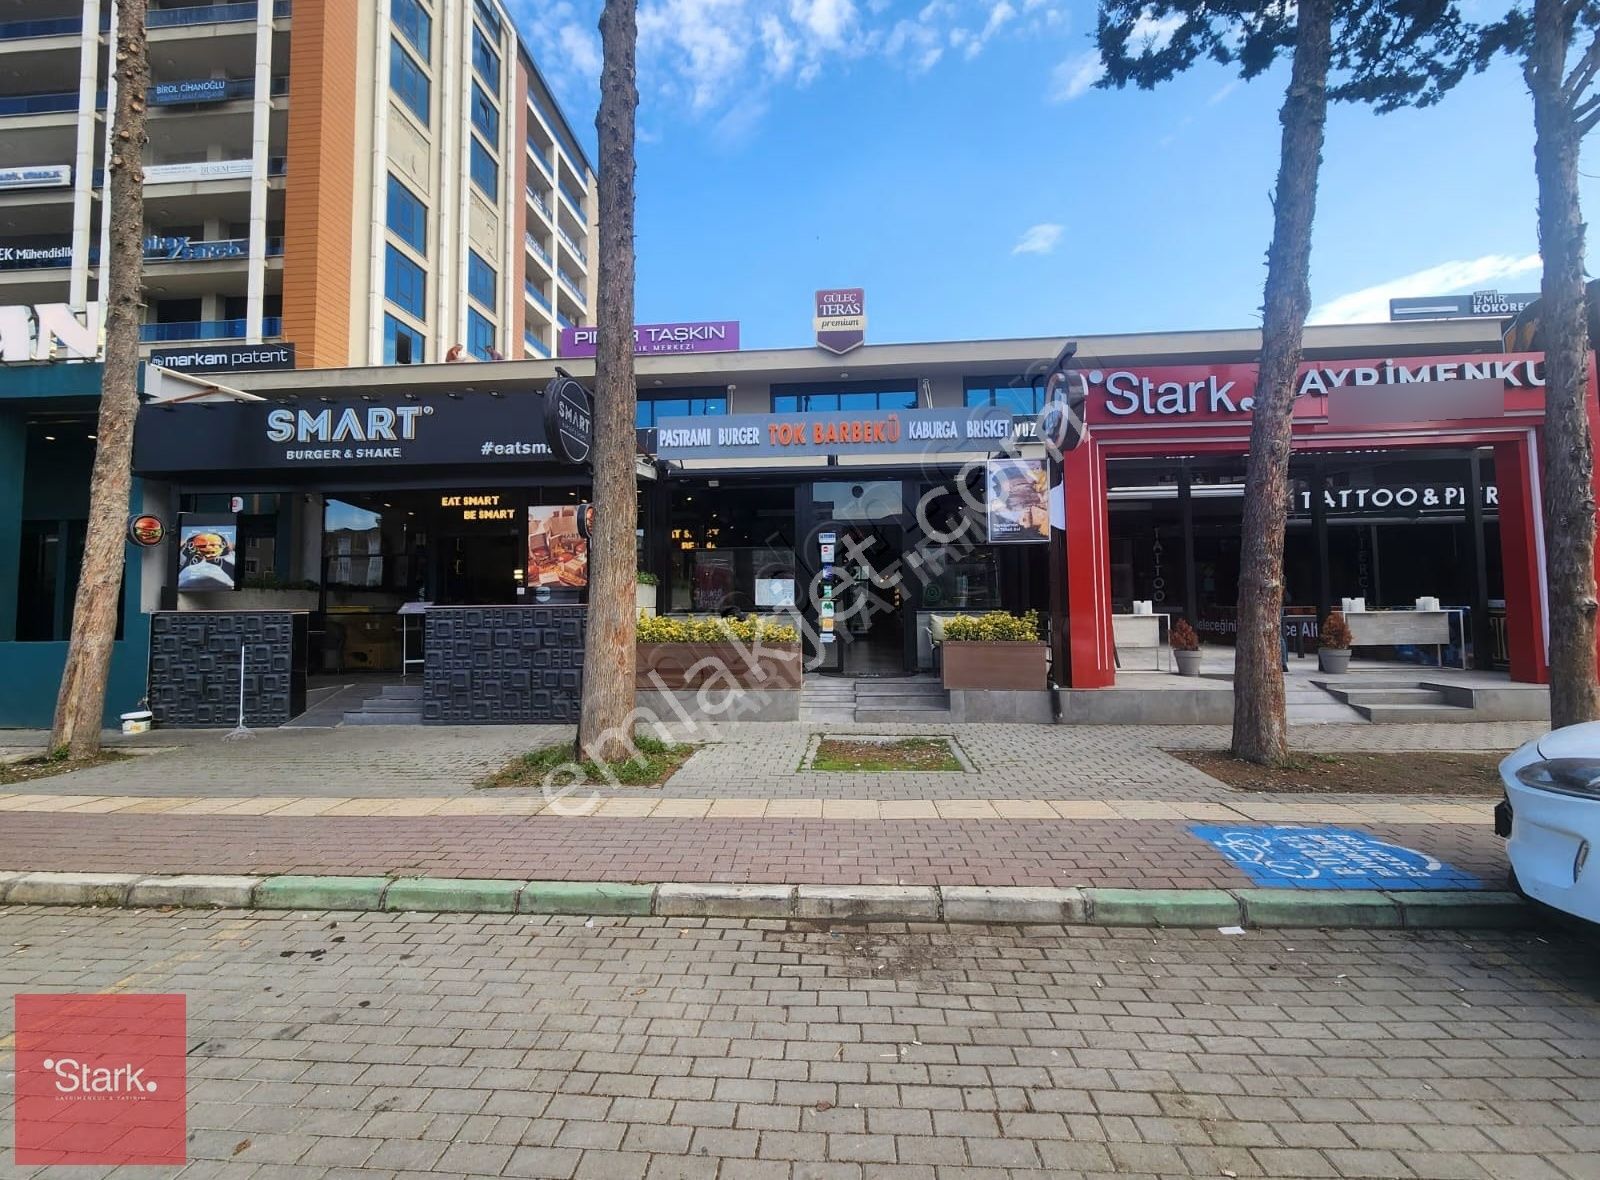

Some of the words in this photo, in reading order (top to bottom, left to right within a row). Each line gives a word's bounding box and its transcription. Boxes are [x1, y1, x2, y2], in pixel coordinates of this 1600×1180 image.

[16, 247, 74, 260] Mühendislik
[823, 292, 857, 304] GÜLEÇ
[820, 303, 861, 316] TERAS
[821, 318, 859, 329] premium
[646, 325, 725, 343] TAŞKIN
[165, 353, 228, 367] markam
[231, 349, 288, 366] patent
[266, 406, 422, 443] SMART
[558, 401, 590, 434] SMART
[659, 428, 712, 447] PASTRAMI
[718, 427, 760, 446] BURGER
[768, 422, 806, 446] TOK
[812, 414, 900, 444] BARBEKÜ
[908, 420, 958, 439] KABURGA
[1012, 423, 1039, 438] VUZ
[286, 450, 342, 460] BURGER
[343, 449, 353, 458] &
[356, 447, 402, 458] SHAKE
[441, 496, 461, 507] EAT
[463, 495, 500, 506] SMART
[463, 510, 477, 520] BE
[478, 509, 515, 520] SMART
[1153, 527, 1166, 602] TATTOO
